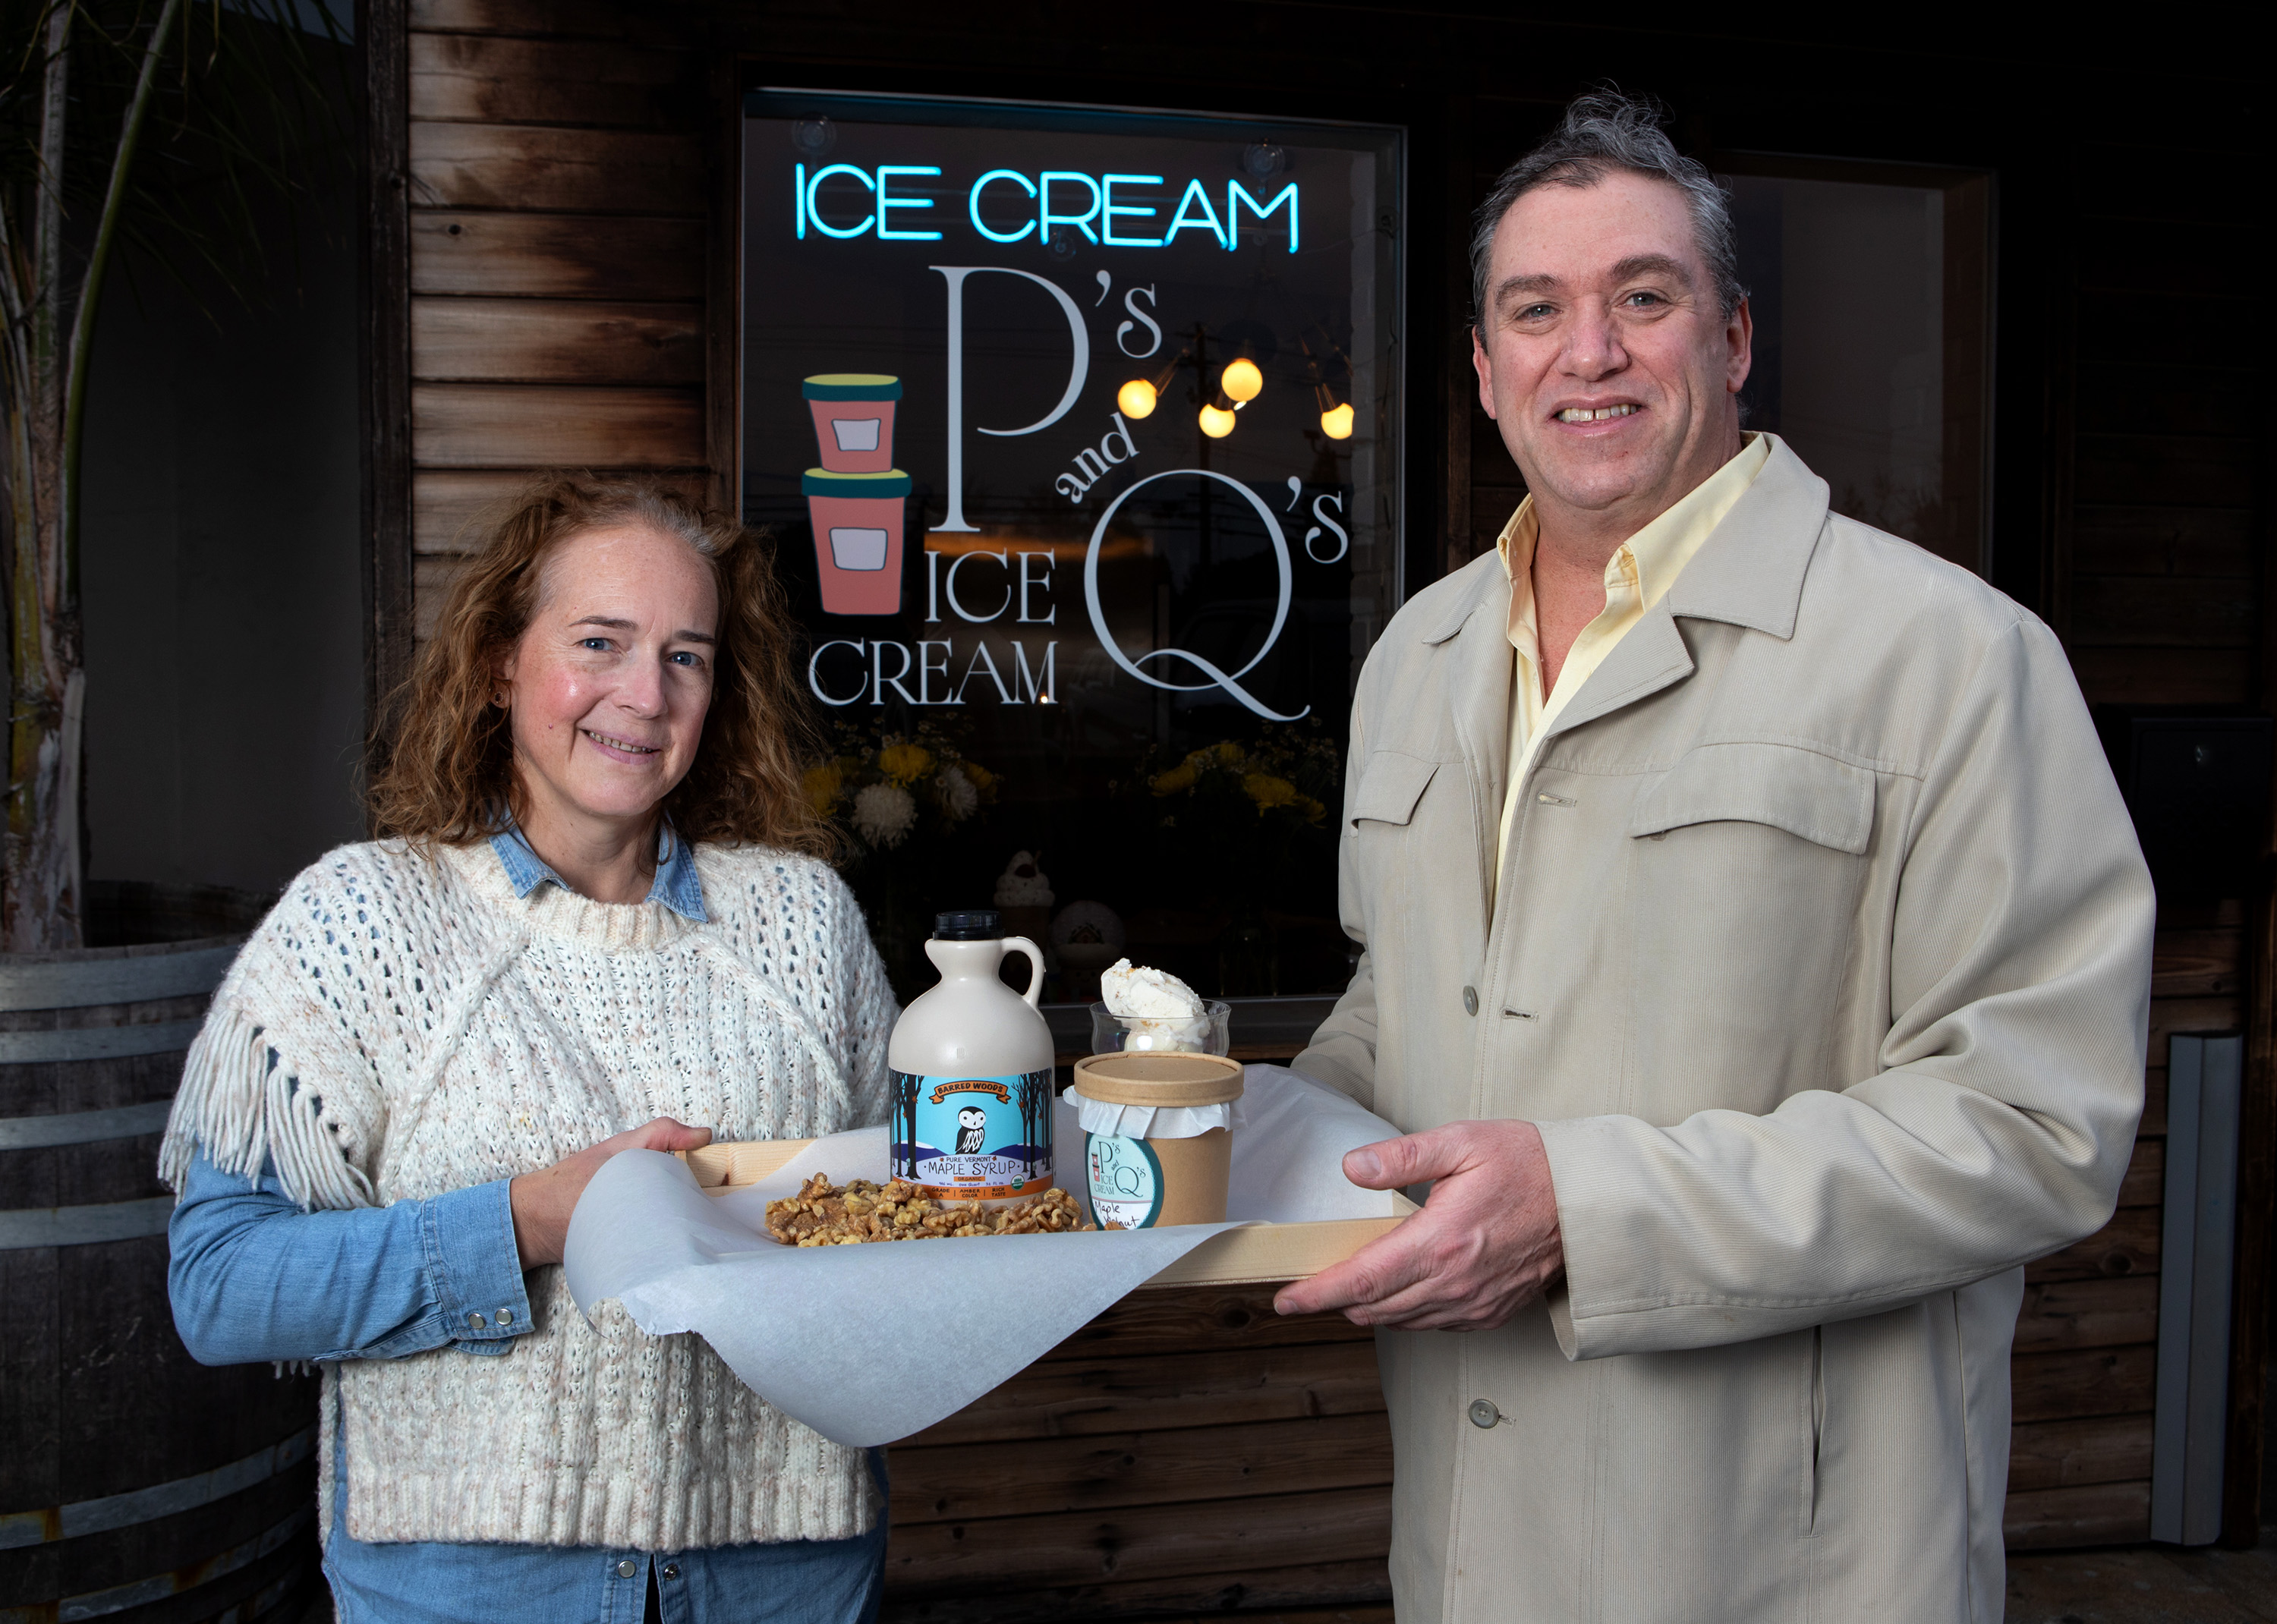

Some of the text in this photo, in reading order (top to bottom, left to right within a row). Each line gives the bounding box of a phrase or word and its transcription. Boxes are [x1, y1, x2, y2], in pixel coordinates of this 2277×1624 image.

[795, 162, 1299, 254] ICE CREAM
[1054, 412, 1140, 504] and
[923, 548, 1057, 625] ICE
[808, 637, 1058, 706] CREAM
[937, 1082, 1003, 1094] BARRED WOODS
[928, 1160, 1016, 1176] MAPLE SYRUP
[1094, 1183, 1115, 1194] CREAM
[1101, 1174, 1113, 1185] ICE
[1094, 1200, 1120, 1218] Maple
